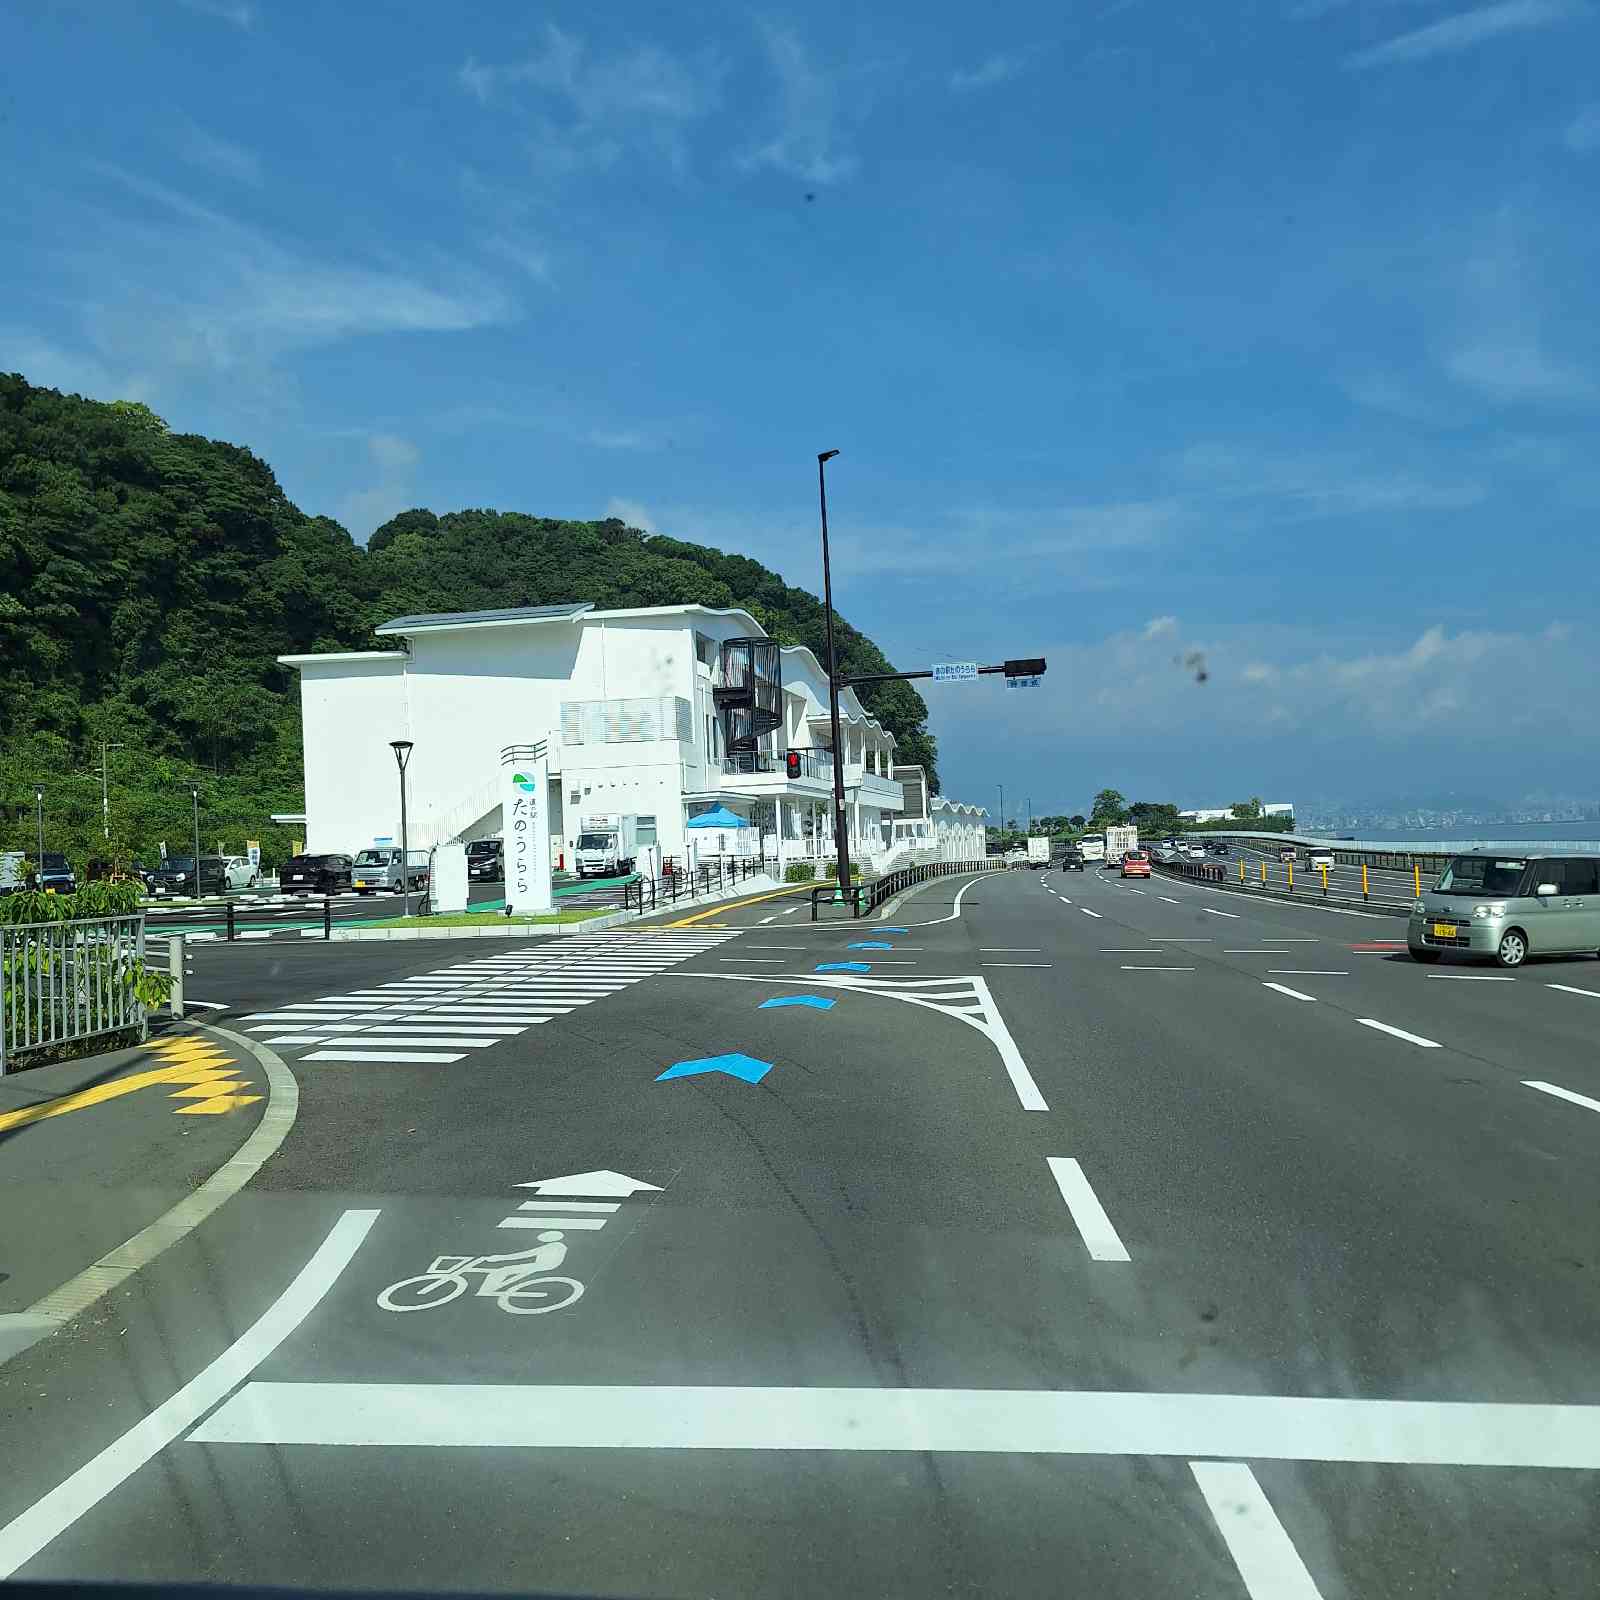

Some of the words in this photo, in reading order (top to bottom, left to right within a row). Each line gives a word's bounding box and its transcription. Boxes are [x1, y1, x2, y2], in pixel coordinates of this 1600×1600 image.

[513, 798, 528, 893] たのうらら
